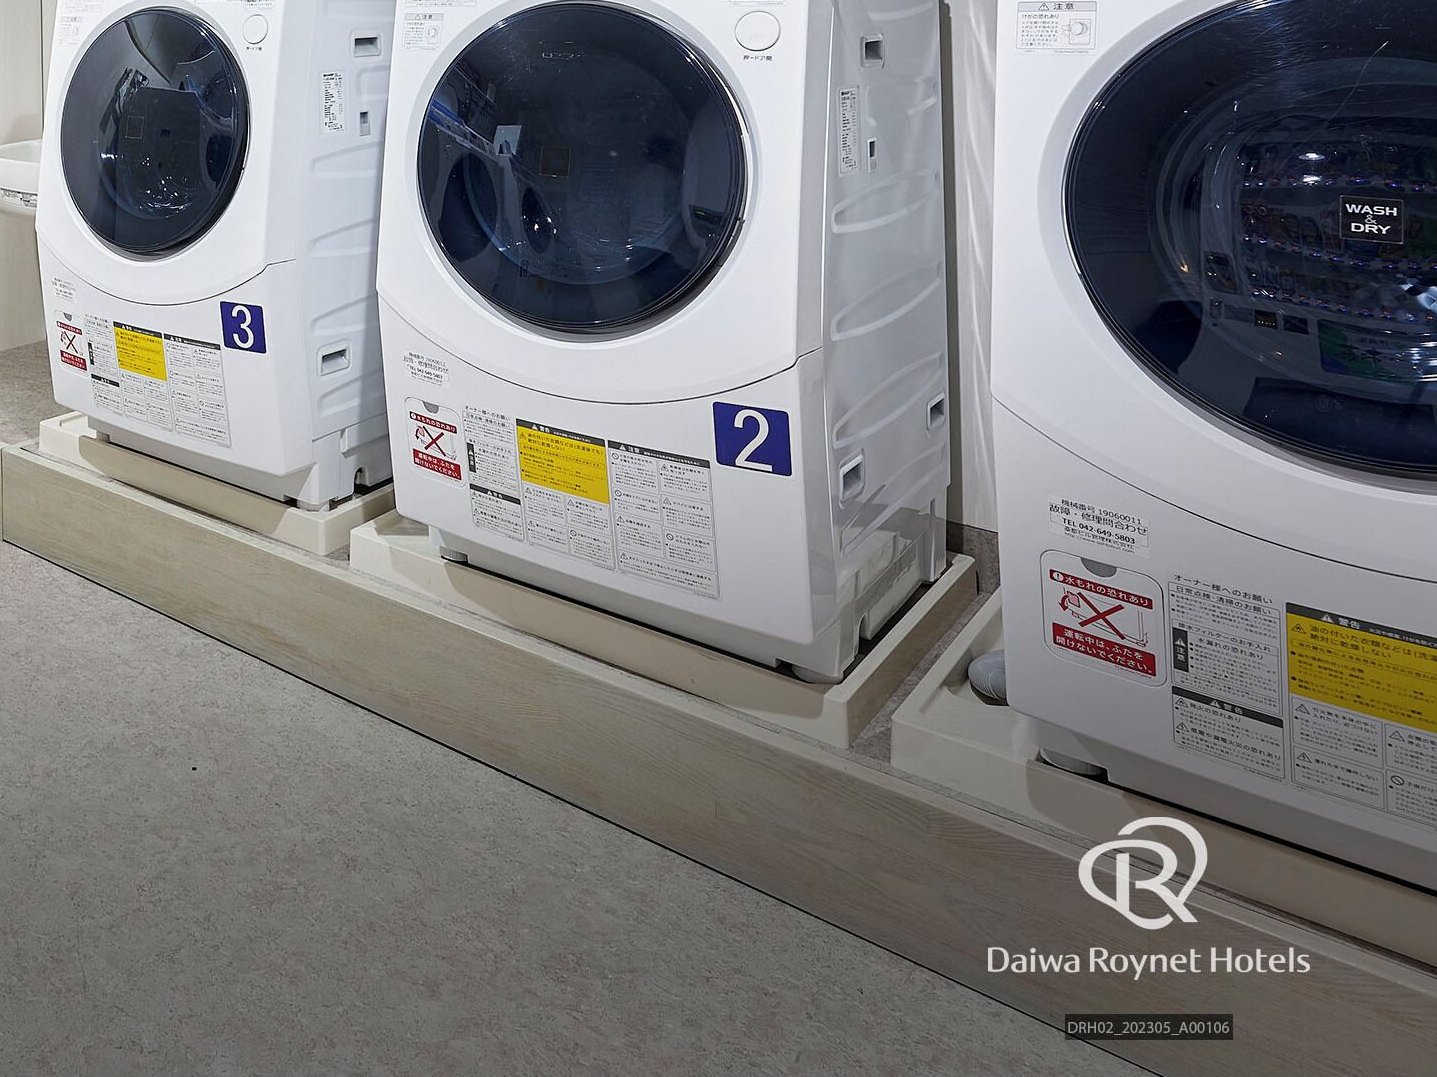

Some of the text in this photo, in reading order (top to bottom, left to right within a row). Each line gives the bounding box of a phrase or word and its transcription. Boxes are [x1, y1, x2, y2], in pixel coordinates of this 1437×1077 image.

[1345, 204, 1397, 216] WASH
[1365, 214, 1377, 224] &
[1351, 223, 1391, 234] DRY
[231, 304, 253, 349] 3
[733, 409, 773, 472] 2
[1063, 517, 1135, 544] TEL 042-649-5803
[1099, 509, 1142, 525] 19060011
[1065, 576, 1149, 606] 水もれの恐れあり
[1174, 574, 1273, 605] オーナー様へのお願い
[1056, 636, 1152, 673] 開けないでください。
[1064, 629, 1144, 660] 運転中は、ふたを
